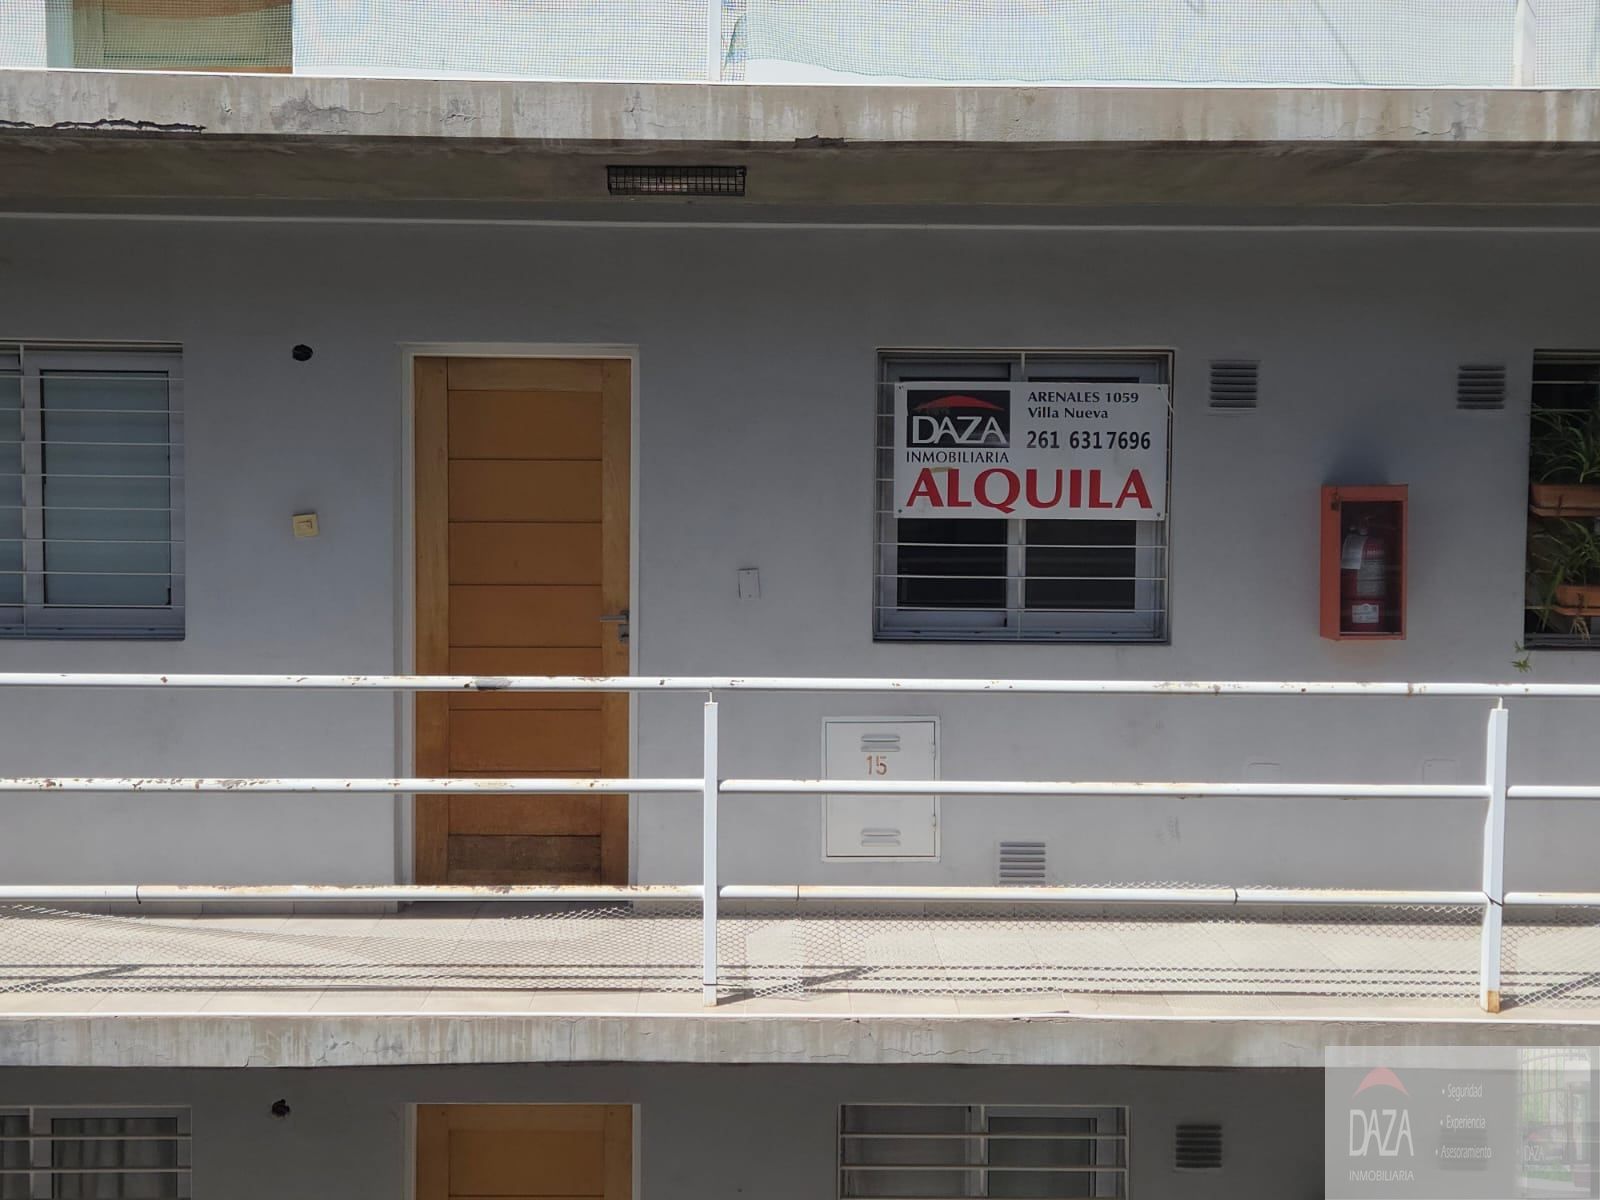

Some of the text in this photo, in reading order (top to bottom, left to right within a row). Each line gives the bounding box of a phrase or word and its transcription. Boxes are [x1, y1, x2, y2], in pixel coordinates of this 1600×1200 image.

[1027, 391, 1139, 403] ARENALES 1059
[1028, 407, 1108, 419] Villa Nueva
[912, 415, 1007, 444] DAZA
[1026, 430, 1151, 450] 261 6317696
[906, 451, 1009, 463] INMOBILIARIA
[906, 467, 1152, 514] ALQUILA
[866, 755, 888, 775] 15
